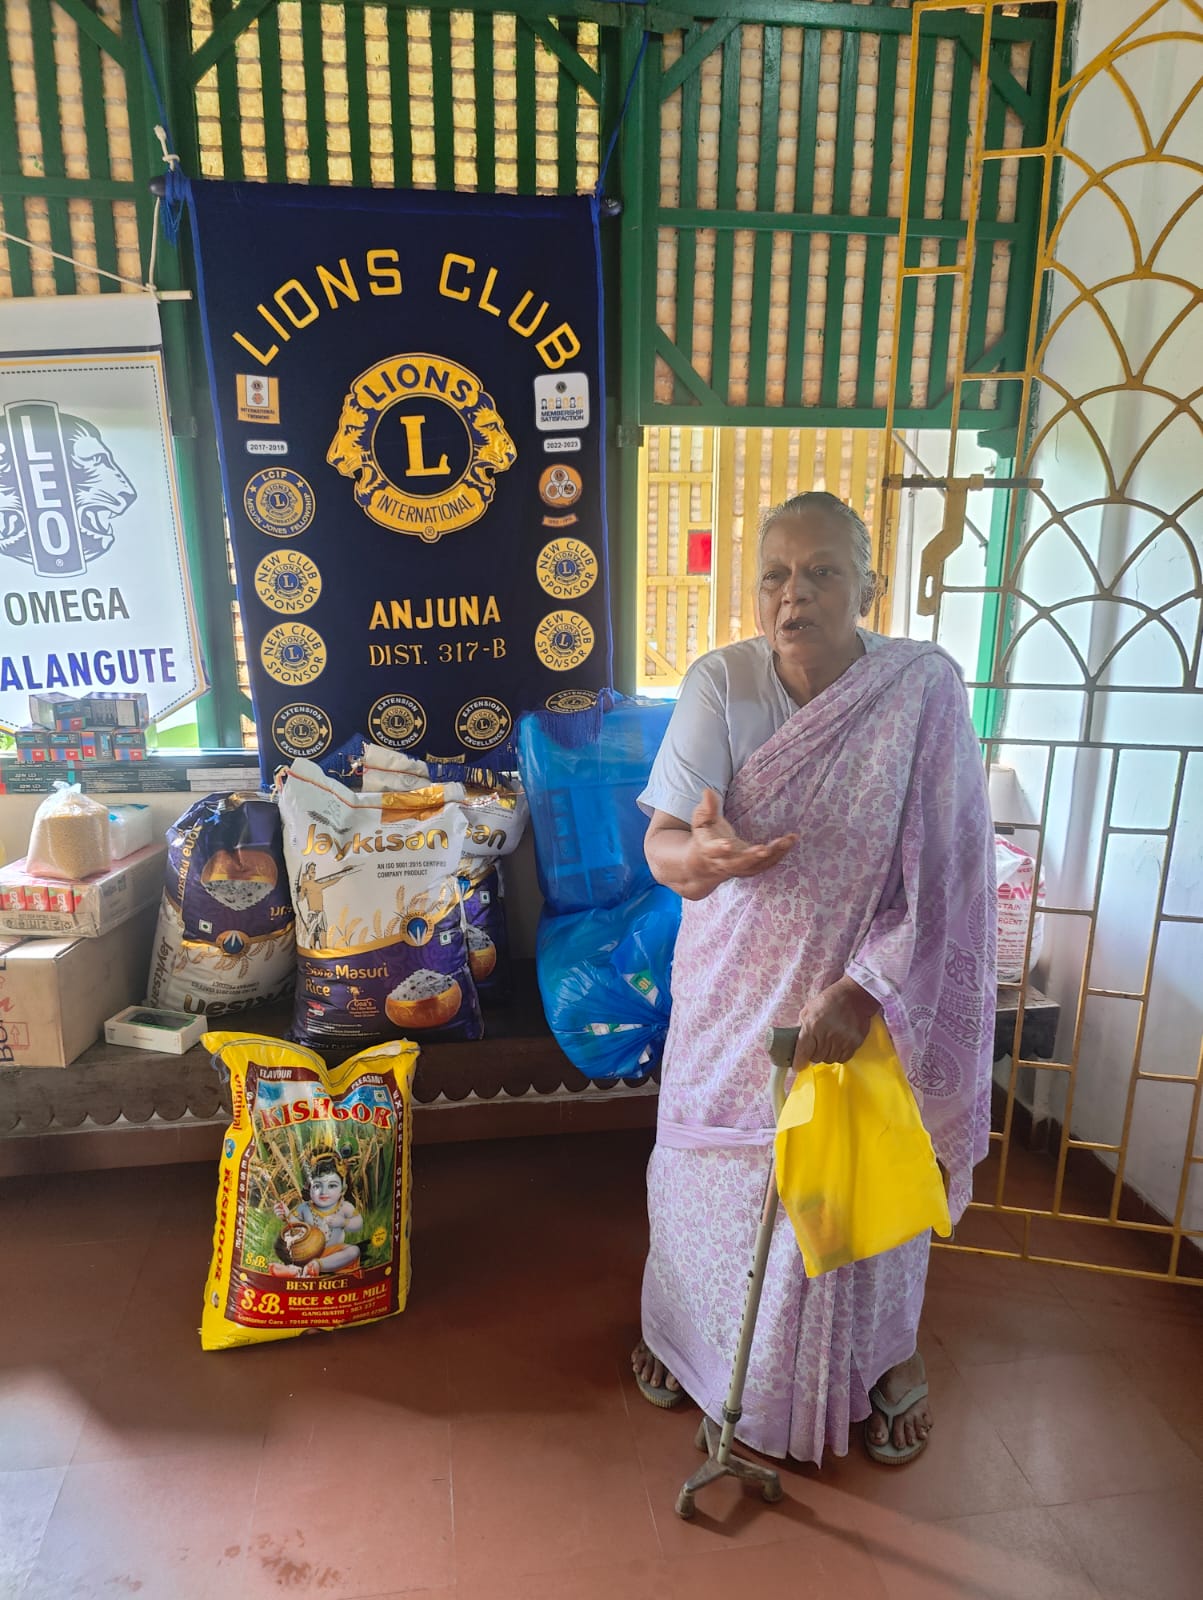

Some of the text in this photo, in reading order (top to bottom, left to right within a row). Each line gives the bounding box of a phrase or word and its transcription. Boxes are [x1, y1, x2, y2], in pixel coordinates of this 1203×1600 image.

[232, 248, 582, 370] LIONS CLUB
[362, 363, 474, 404] LIONS
[540, 408, 584, 417] MEMBERSHIP
[540, 414, 585, 423] SATISFACTION
[399, 414, 452, 478] L
[20, 415, 71, 556] LEO
[260, 470, 288, 482] LCIF
[247, 492, 312, 534] MELVIN JONES FELLOWSHIP
[375, 494, 476, 524] INTERNATIONAL
[258, 552, 318, 582] NEW CLUB
[540, 541, 594, 569] NEW CLUB
[541, 572, 594, 596] SPONSOR
[5, 587, 130, 627] OMEGA
[260, 586, 318, 611] SPONSOR
[368, 595, 501, 632] ANJUNA
[539, 612, 592, 643] NEW CLUB
[263, 625, 322, 656] NEW CLUB
[368, 638, 507, 668] DIST. 317-B
[538, 641, 587, 668] SPONSOR
[267, 656, 324, 683] SPONSOR
[280, 706, 323, 721] EXTENSION
[377, 697, 419, 712] EXTENSION
[461, 700, 503, 718] EXTENSION
[280, 740, 325, 757] EXCELLENCE
[375, 730, 419, 747] EXCELLENCE
[463, 729, 507, 747] EXCELLENCE
[302, 823, 449, 862] Jaykisan
[377, 869, 428, 879] COMPANY PRODUCT
[305, 961, 390, 980] Sona Masuri
[305, 978, 331, 997] Rice
[259, 1068, 293, 1079] FLAVOUR
[351, 1075, 384, 1091] PLEASANT
[394, 1167, 402, 1243] QUALITY
[245, 1252, 268, 1269] S.B.
[286, 1278, 348, 1291] BEST RICE
[288, 1296, 319, 1306] RICE
[323, 1295, 335, 1305] &
[338, 1292, 359, 1304] OIL
[362, 1283, 388, 1299] MILL
[240, 1288, 285, 1315] S.B.
